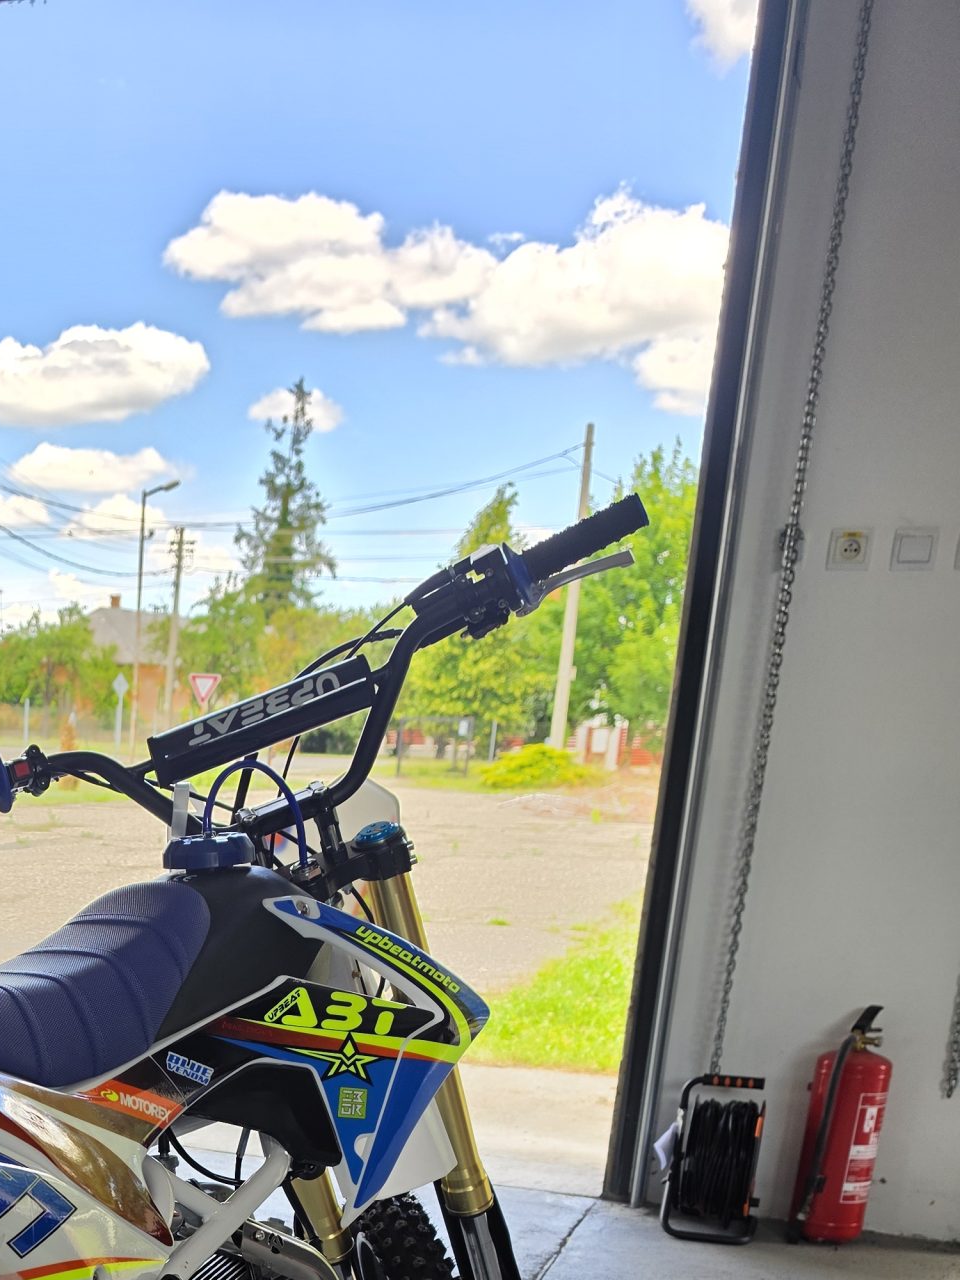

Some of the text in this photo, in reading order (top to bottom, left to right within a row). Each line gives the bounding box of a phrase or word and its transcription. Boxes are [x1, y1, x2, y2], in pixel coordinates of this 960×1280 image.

[355, 924, 461, 994] upbeatmoto
[166, 1062, 210, 1085] VENOM
[167, 1052, 214, 1078] BLUE
[120, 1092, 172, 1122] MOTOREX
